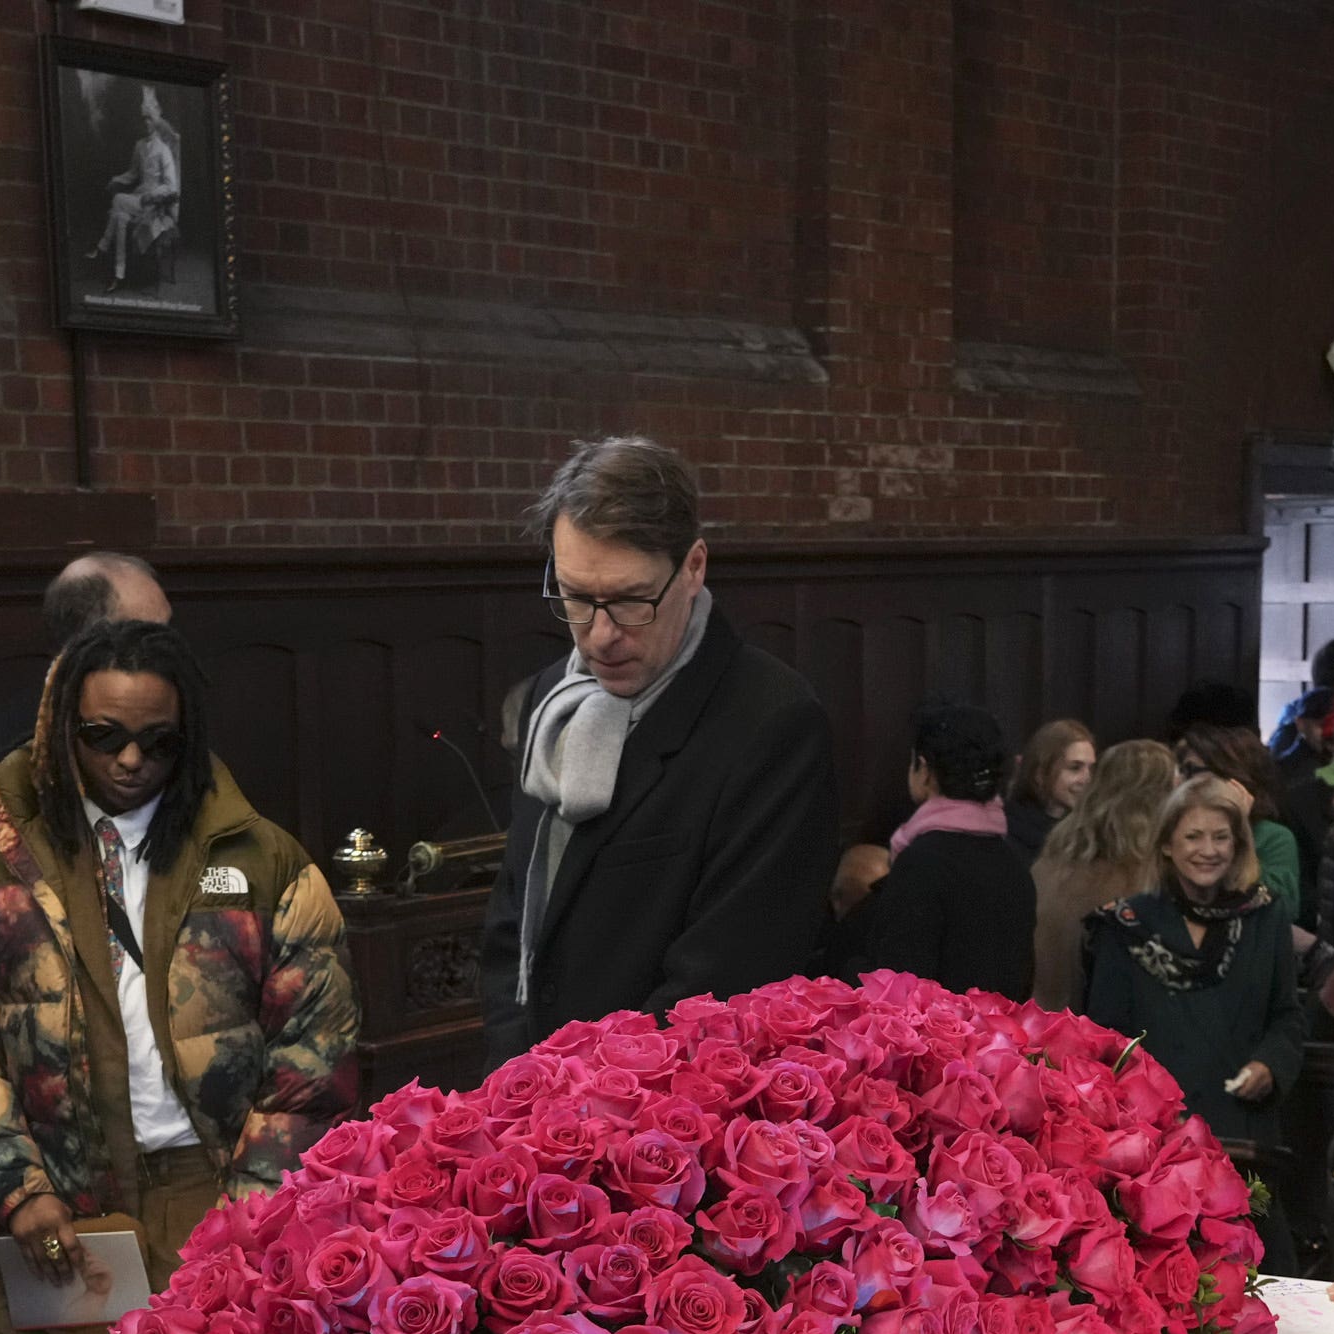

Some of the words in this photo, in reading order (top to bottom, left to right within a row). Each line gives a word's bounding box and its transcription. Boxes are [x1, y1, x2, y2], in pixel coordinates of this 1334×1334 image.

[206, 866, 229, 877] THE
[198, 876, 229, 886] ORTH
[201, 885, 230, 894] FACE
